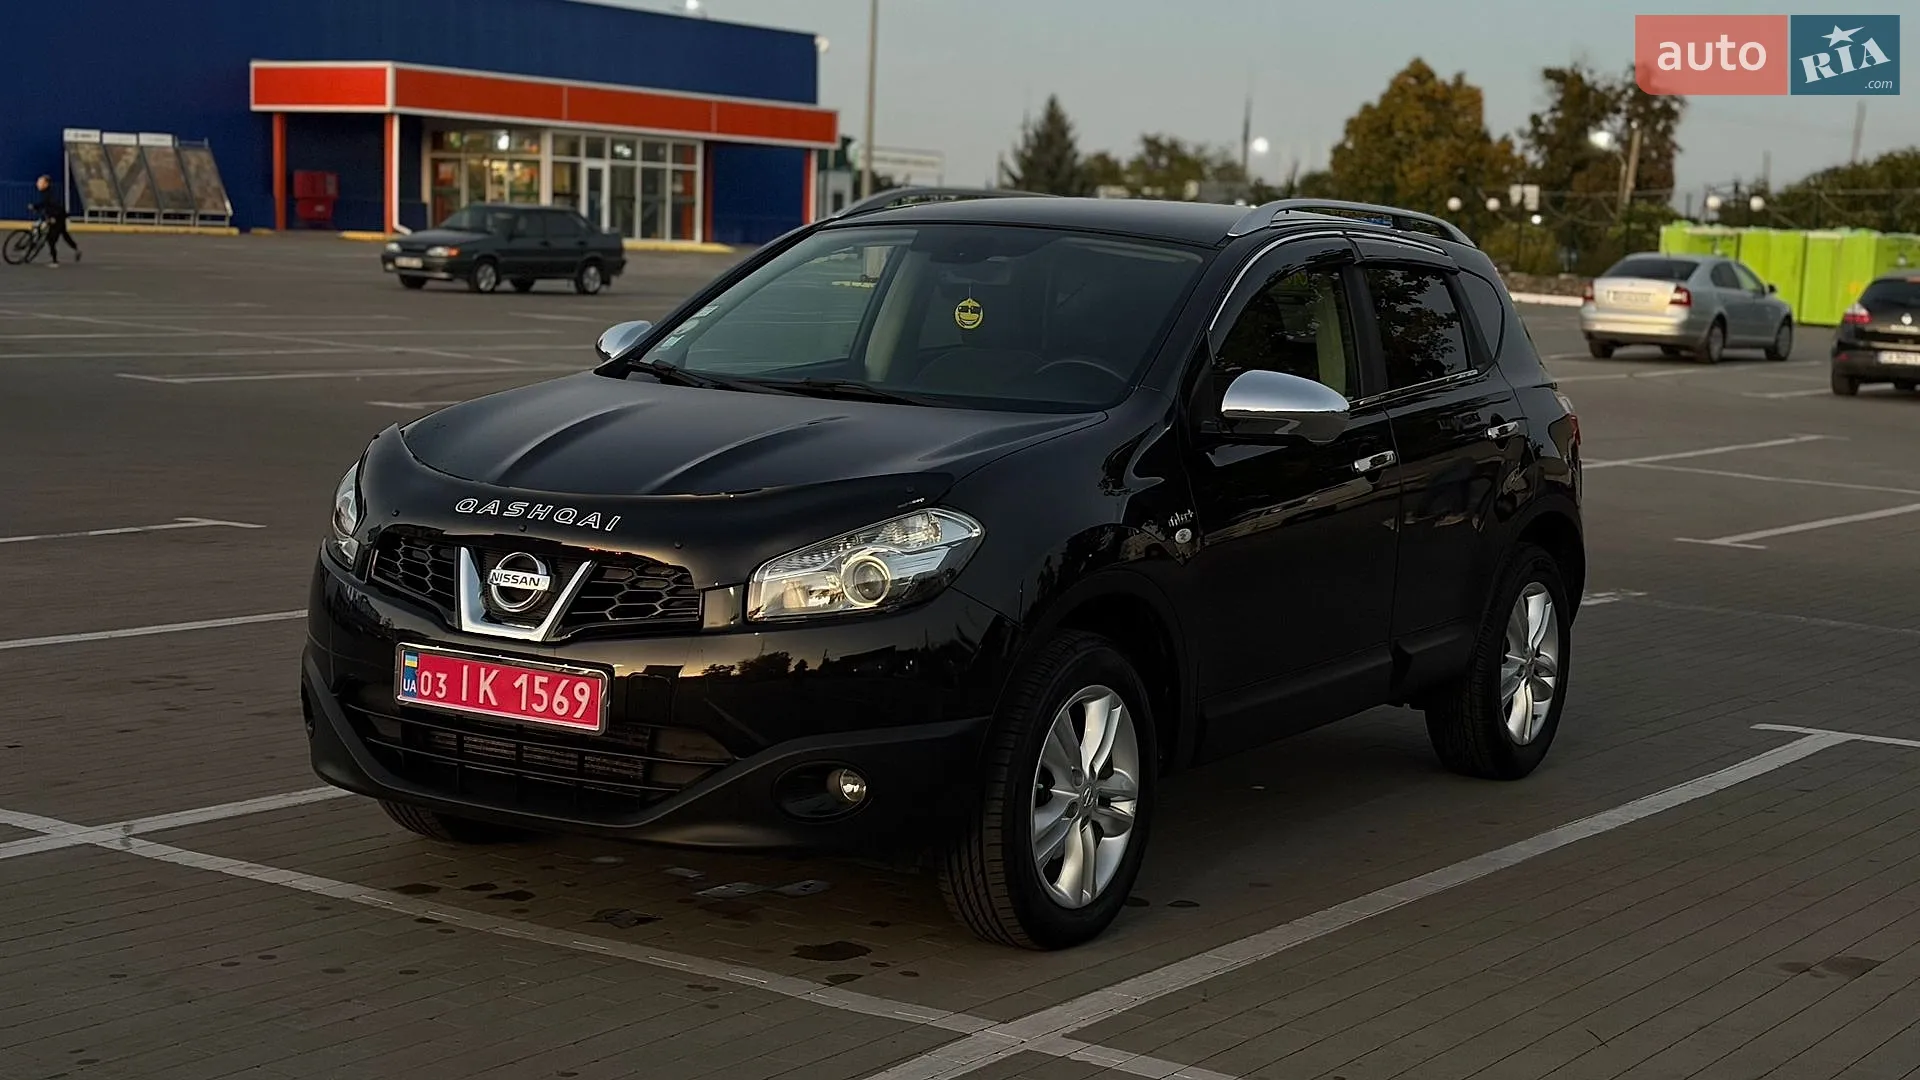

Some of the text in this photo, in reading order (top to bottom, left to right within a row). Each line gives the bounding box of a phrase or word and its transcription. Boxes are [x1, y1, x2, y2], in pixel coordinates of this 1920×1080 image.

[454, 497, 622, 531] QASHQAI
[491, 571, 541, 587] NISSAN
[403, 678, 417, 693] UA
[419, 664, 592, 719] 03 IK 1569
